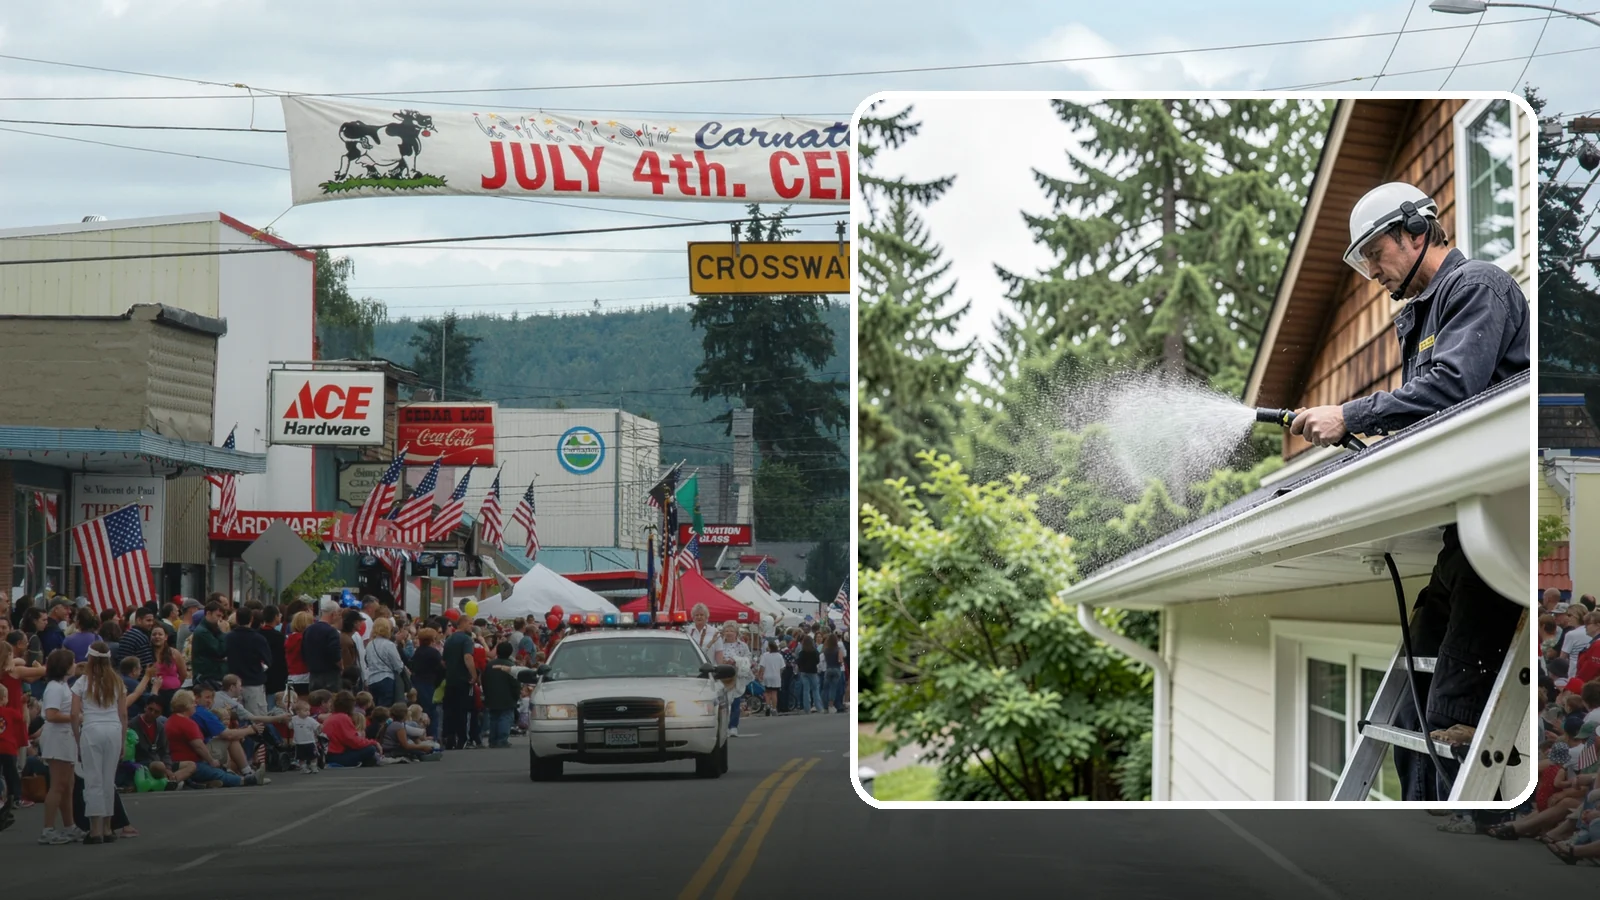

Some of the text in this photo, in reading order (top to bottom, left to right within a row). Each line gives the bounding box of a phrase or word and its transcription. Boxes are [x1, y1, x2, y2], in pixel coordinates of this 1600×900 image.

[481, 141, 605, 192] JULY
[632, 150, 746, 198] 4th.
[697, 254, 850, 280] CROSSWA
[282, 380, 373, 420] ACE
[405, 409, 485, 422] CEDAR LOG
[283, 421, 371, 436] Hardware
[416, 428, 476, 447] Coca-Cola
[353, 467, 385, 482] Simpl
[83, 484, 155, 496] St. Vincent de Paul
[688, 526, 741, 535] CRNATION
[699, 535, 730, 543] GLASS
